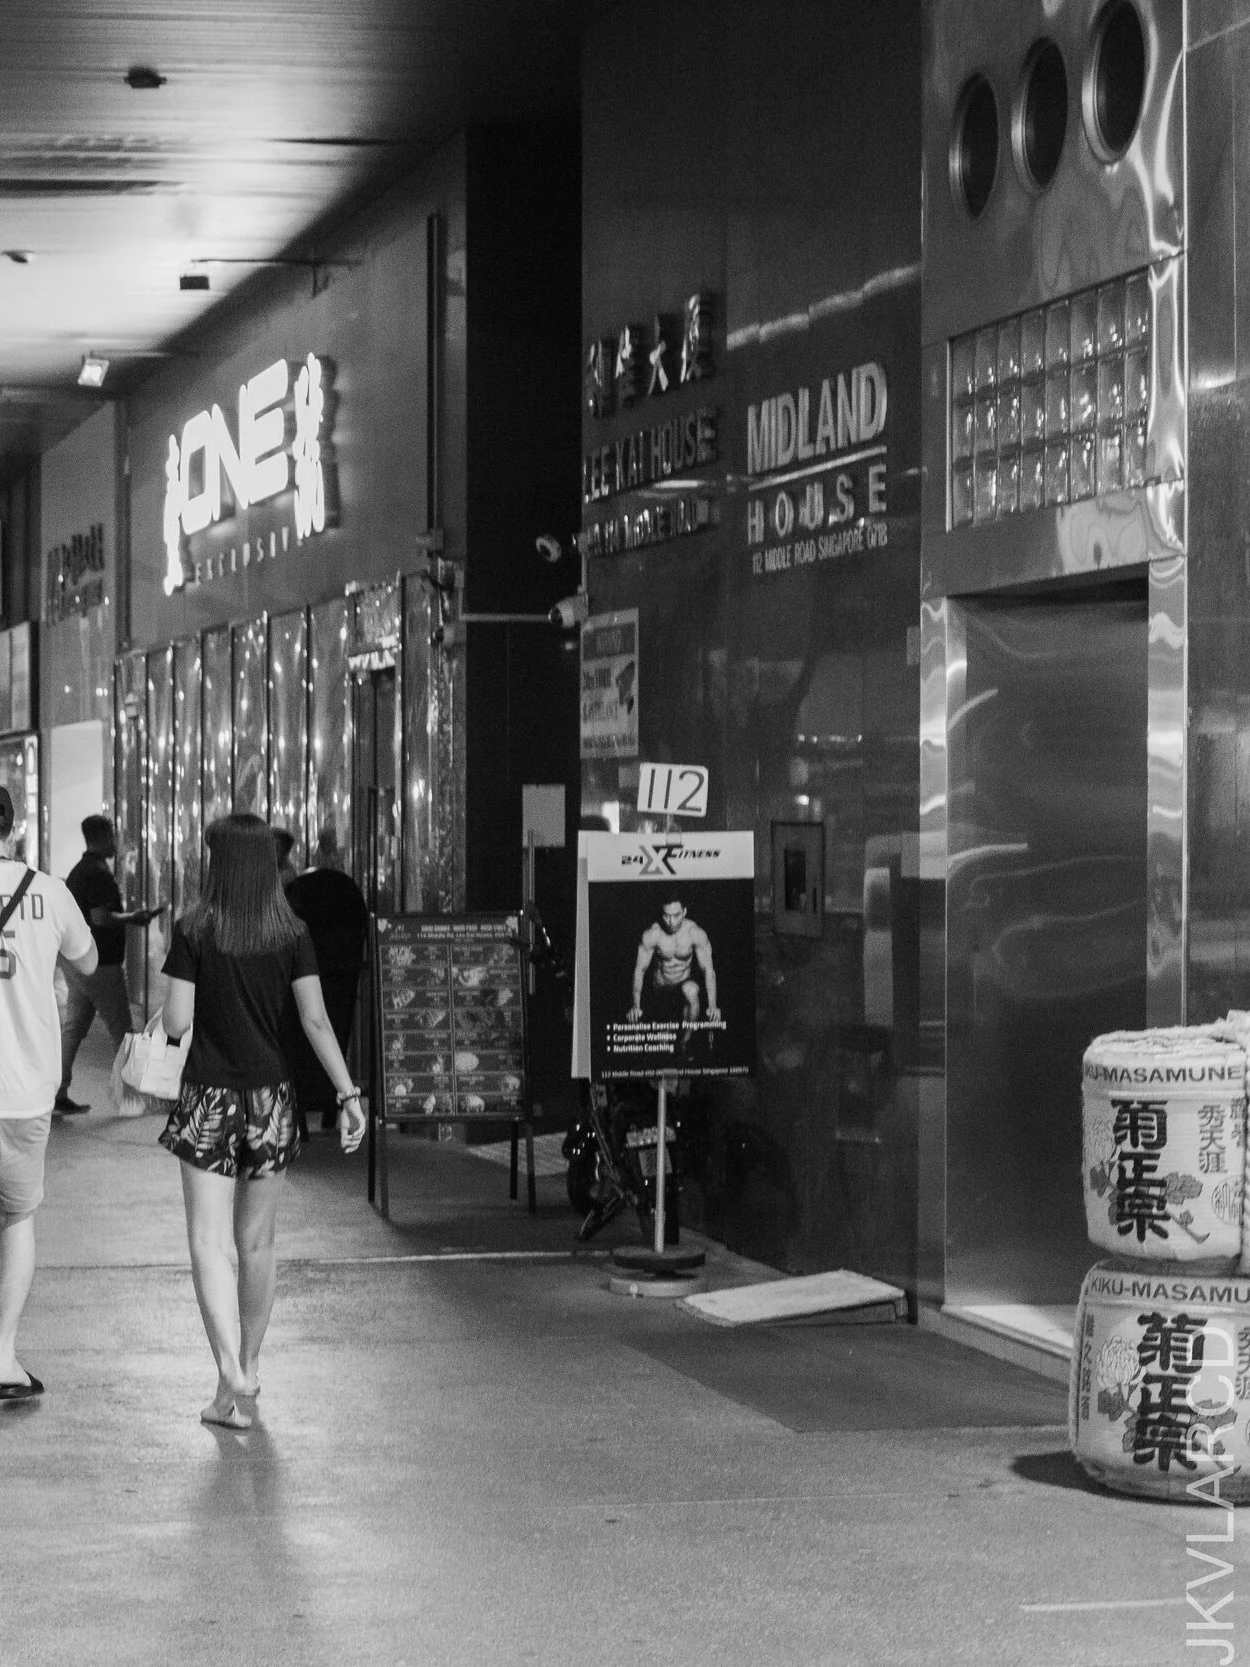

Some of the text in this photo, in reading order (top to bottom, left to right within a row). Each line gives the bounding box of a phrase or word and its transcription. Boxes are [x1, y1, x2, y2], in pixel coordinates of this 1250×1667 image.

[180, 358, 288, 536] ONE
[650, 407, 715, 479] HOUSE
[748, 361, 888, 475] MIDLAND
[748, 463, 887, 545] HOUSE
[764, 544, 792, 572] MIDDLE
[794, 539, 816, 566] ROAD
[818, 527, 864, 560] SINGAPORE
[646, 768, 705, 812] 112
[613, 1020, 727, 1031] Personalise Exercise Programming
[613, 1032, 677, 1043] Corporate Wellness
[613, 1043, 674, 1053] Nutrition Coaching
[1133, 1311, 1208, 1472] 菊正宗
